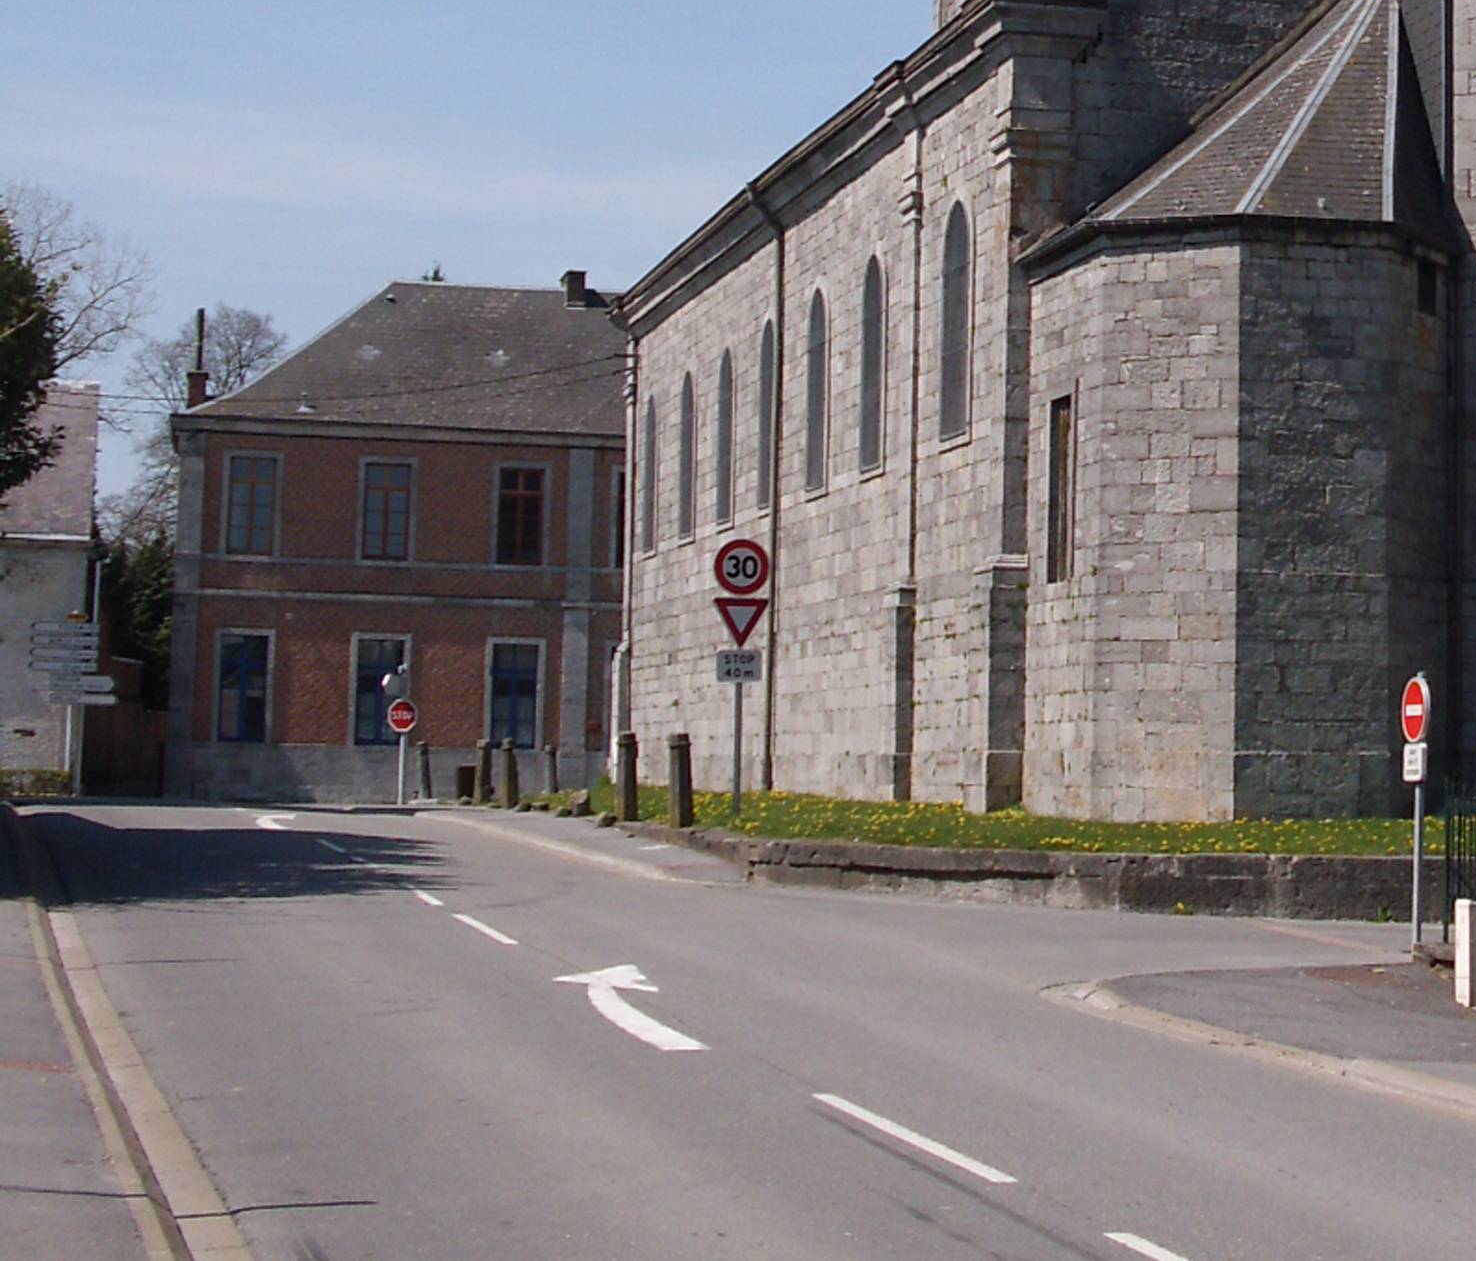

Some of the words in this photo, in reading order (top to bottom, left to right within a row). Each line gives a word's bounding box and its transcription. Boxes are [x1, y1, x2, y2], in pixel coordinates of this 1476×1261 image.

[726, 555, 758, 578] 30
[724, 654, 755, 664] STOP
[392, 710, 413, 720] STOP
